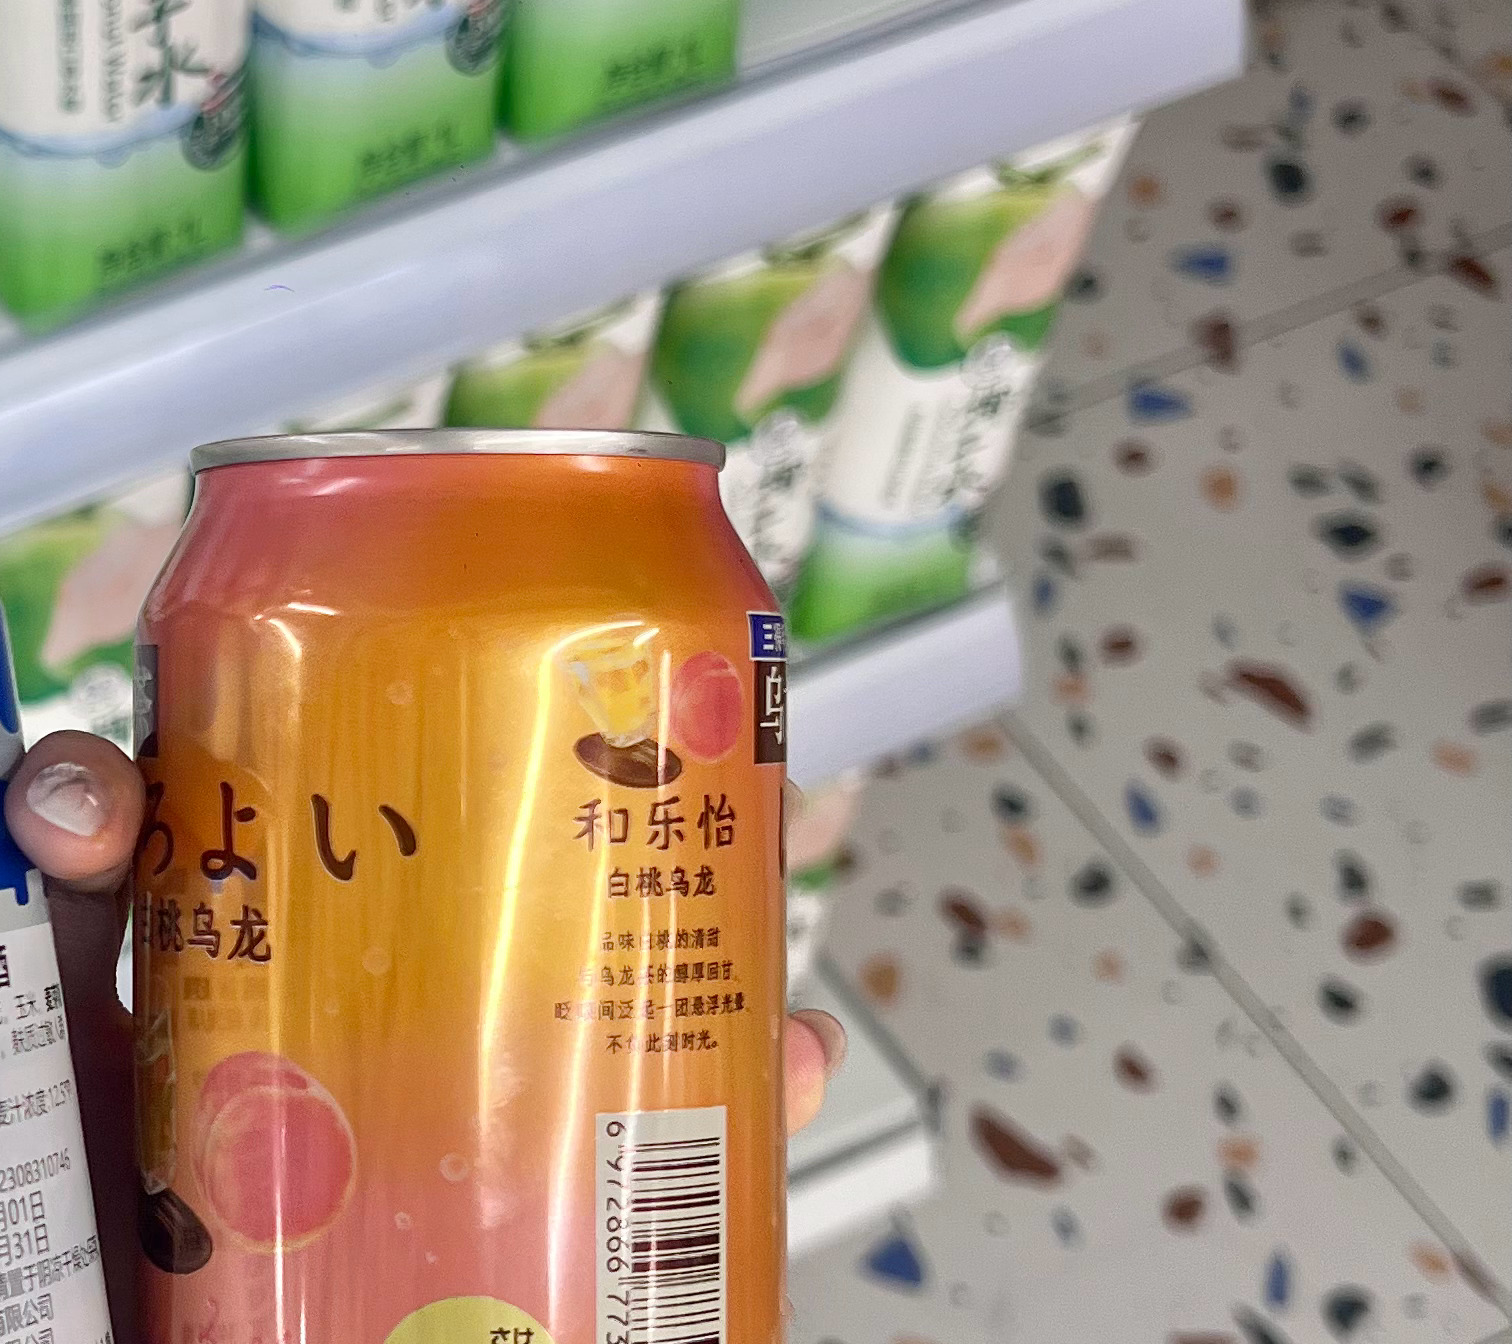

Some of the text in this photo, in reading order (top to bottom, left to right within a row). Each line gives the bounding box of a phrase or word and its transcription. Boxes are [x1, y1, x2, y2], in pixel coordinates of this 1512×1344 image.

[573, 793, 736, 851] 和乐怡
[608, 864, 715, 899] 白桃乌龙
